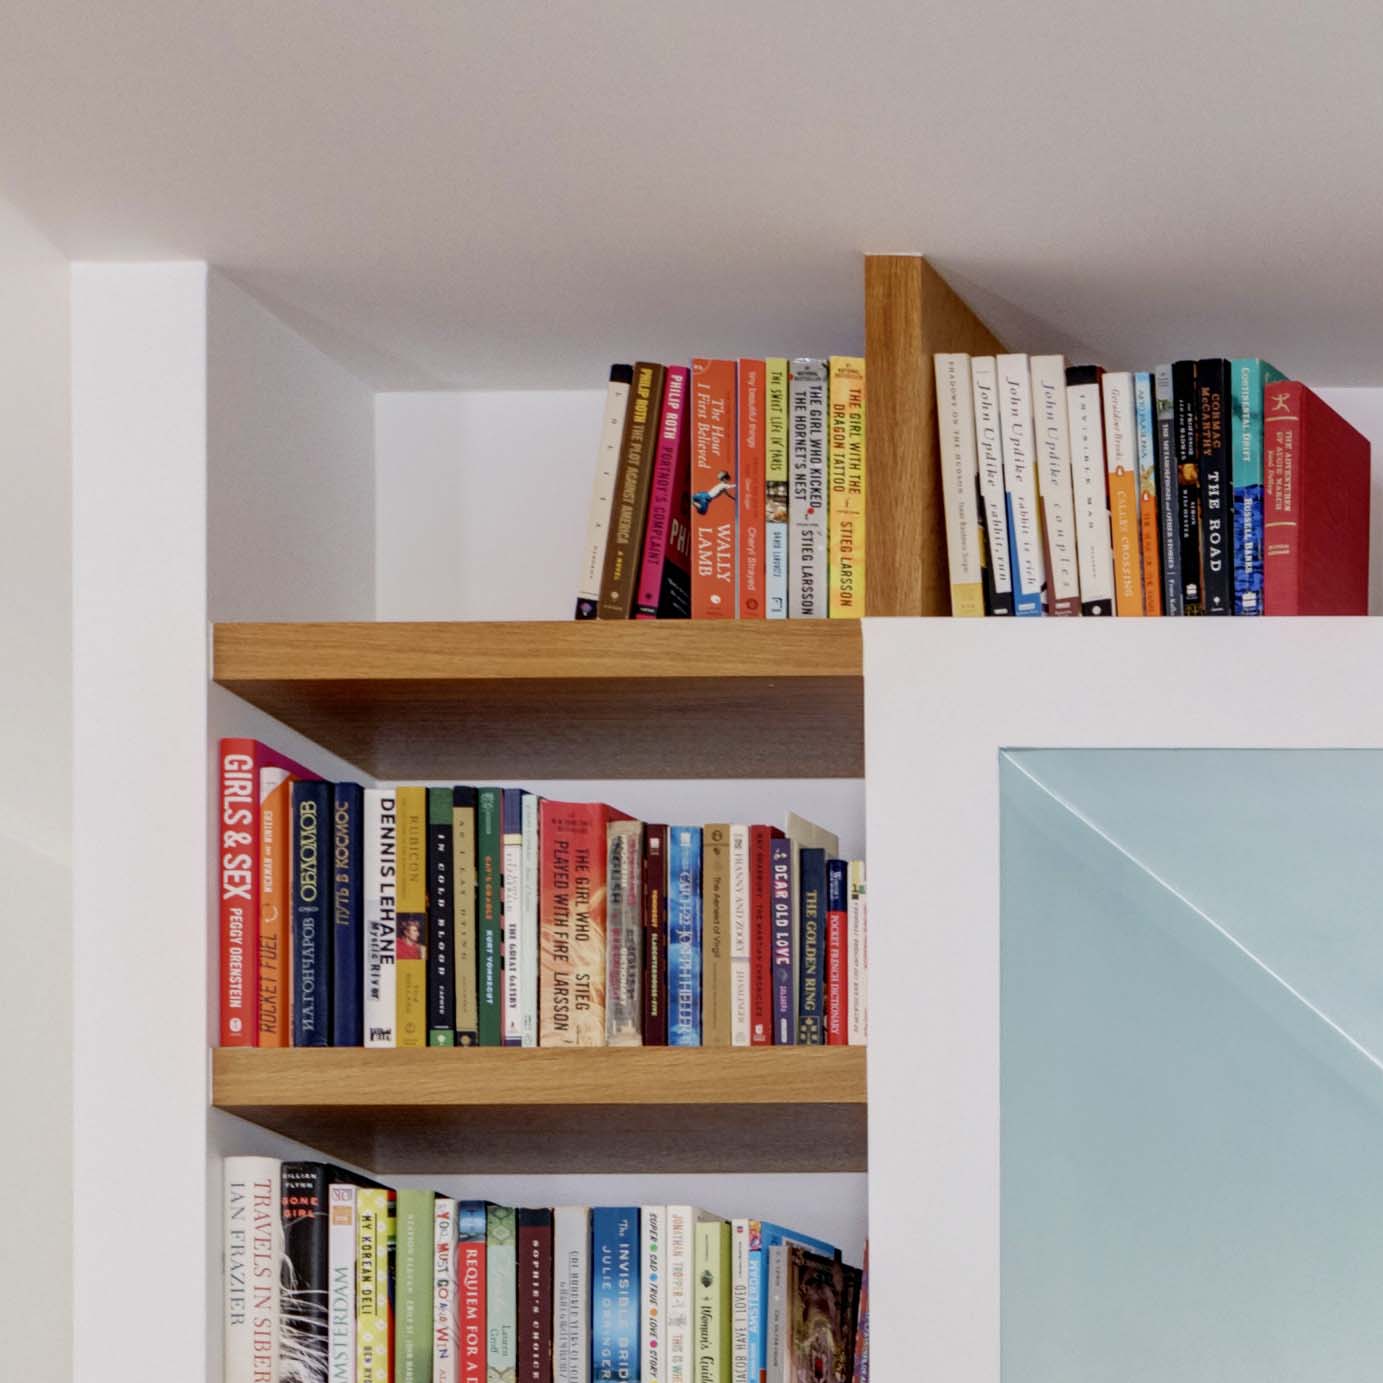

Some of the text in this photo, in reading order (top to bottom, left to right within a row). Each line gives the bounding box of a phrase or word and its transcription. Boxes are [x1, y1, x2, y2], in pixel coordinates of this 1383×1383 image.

[664, 374, 682, 439] PHILIP ROTH
[795, 392, 806, 501] THE HORNET'S NEST
[811, 386, 822, 509] THE GIRL WHO KICKED
[833, 404, 845, 492] DRAGON TATTOO
[849, 389, 861, 494] THE GIRL WITH THE
[1211, 393, 1221, 448] CORMAC
[699, 528, 712, 576] LAMB
[716, 524, 730, 582] WALLY
[840, 521, 852, 607] STIEG LARSSON
[1208, 472, 1222, 573] THE ROAD
[802, 530, 813, 615] STIEG LARSSON
[223, 754, 253, 900] GIRLS & SEX
[299, 800, 317, 902] ОБЛОМОВ
[336, 801, 349, 868] КОСМОС
[336, 888, 350, 926] ПУТЬ
[380, 798, 395, 965] DENNIS LEHANE
[553, 840, 569, 962] PLAYED WITH FIRE
[575, 849, 590, 942] THE GIRL WHO
[774, 865, 790, 965] DEAR OLD LOVE
[228, 908, 242, 1008] PEGGY ORENSTEIN
[554, 972, 569, 1031] LARSSON
[576, 974, 590, 1011] STIEG
[230, 1183, 245, 1327] IAN FRAZIER
[253, 1179, 272, 1278] TRAVELS
[253, 1286, 272, 1310] IN
[464, 1249, 479, 1319] REQUIEM
[466, 1325, 479, 1357] FOR
[466, 1361, 479, 1372] A
